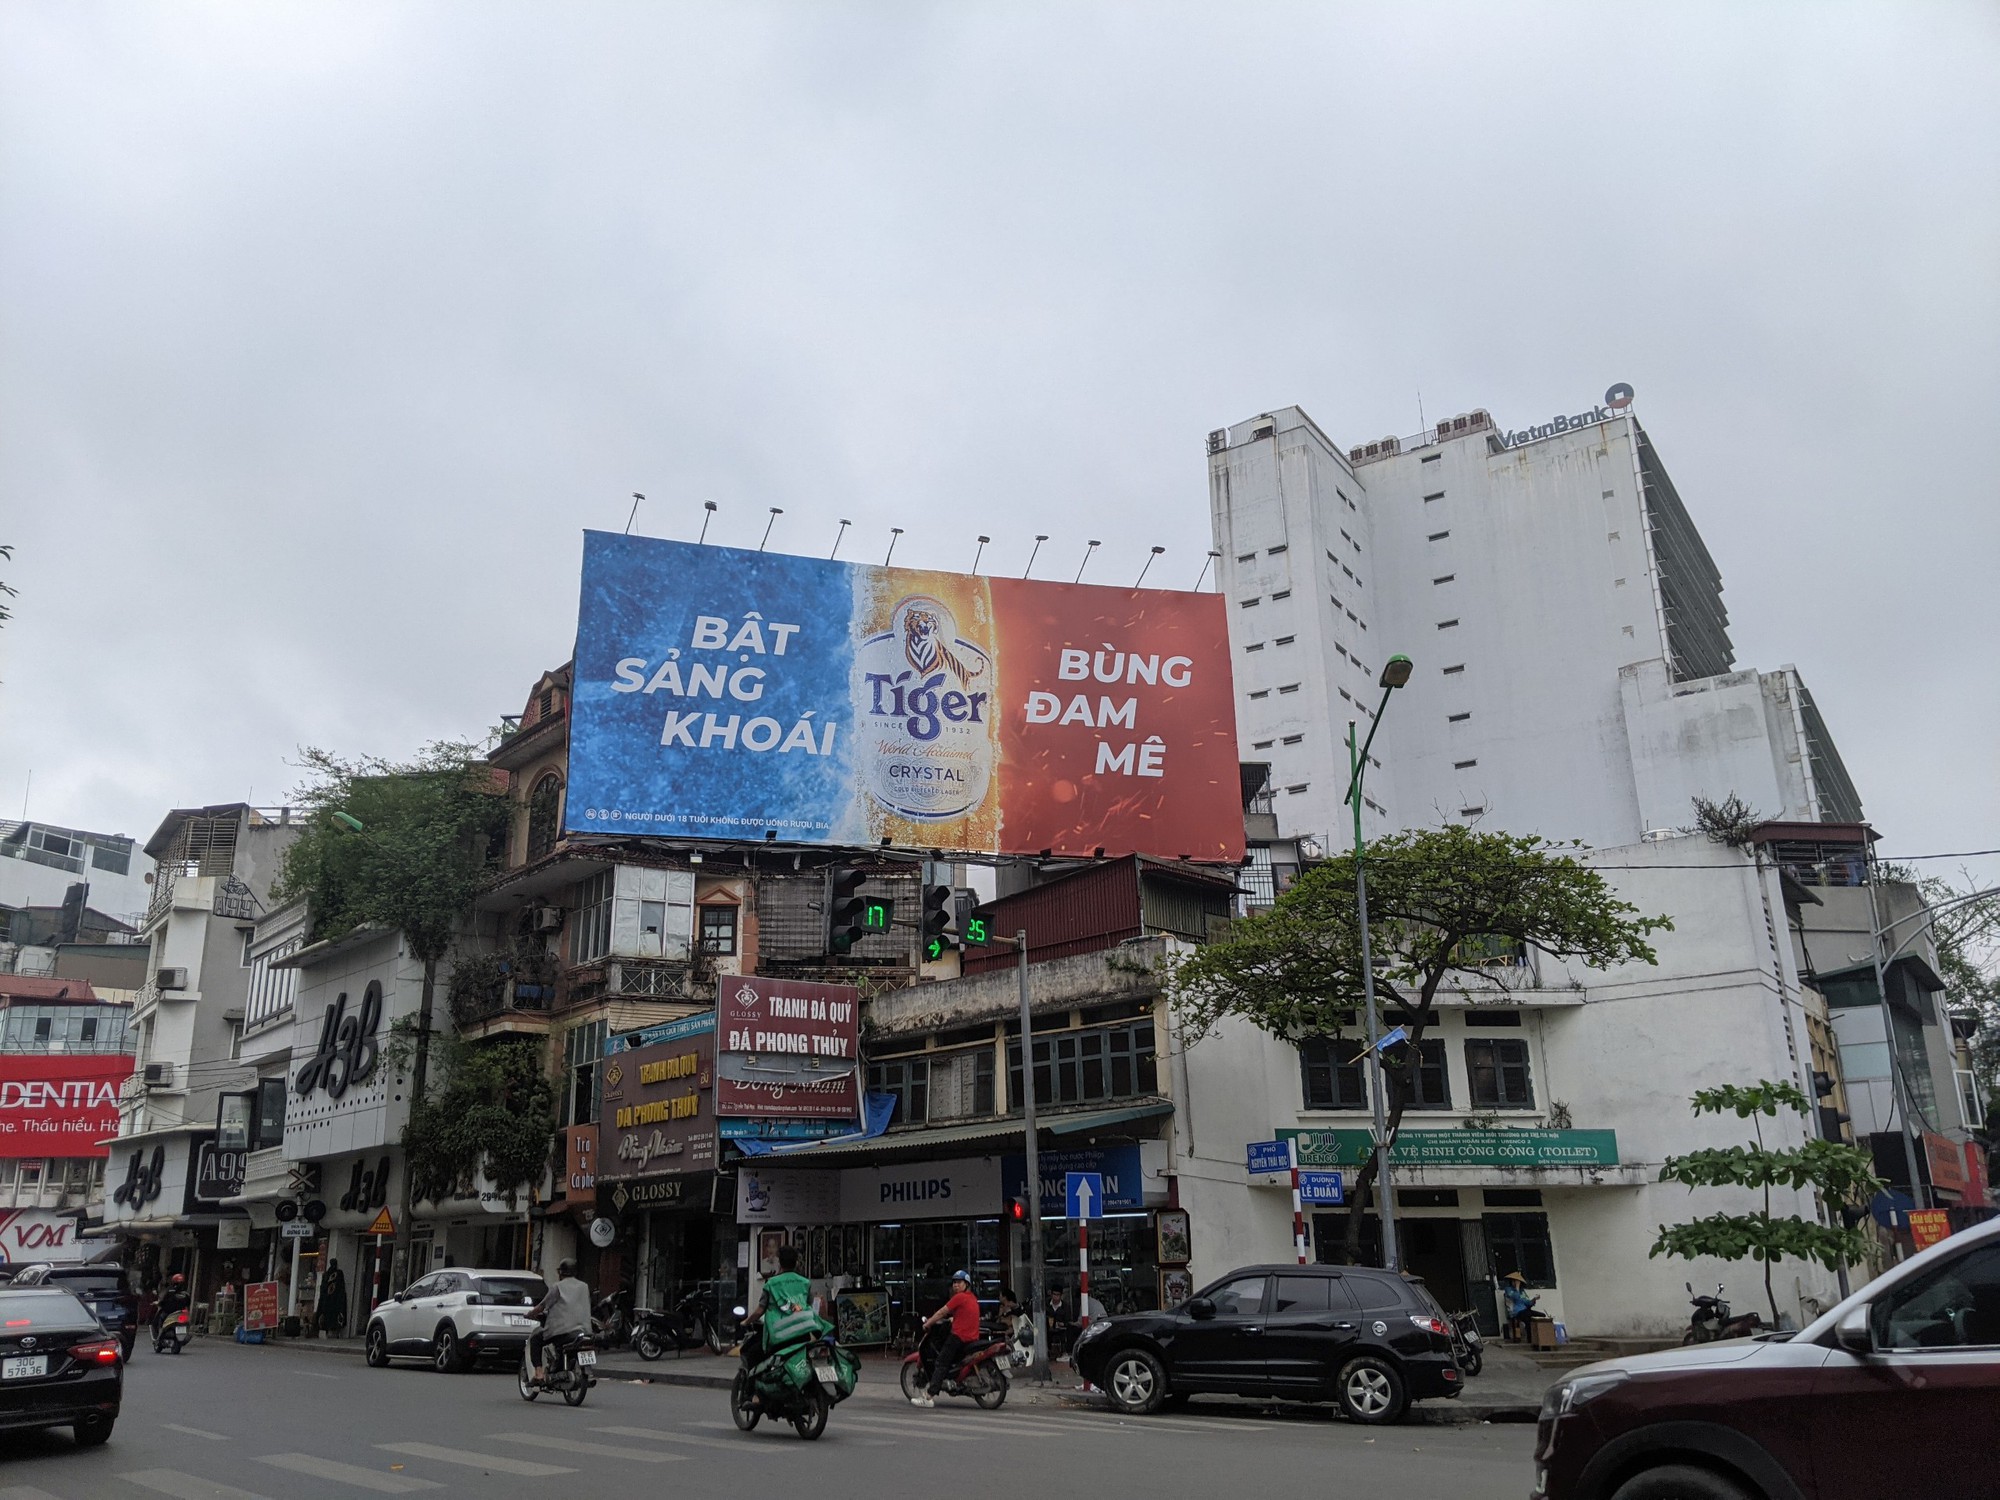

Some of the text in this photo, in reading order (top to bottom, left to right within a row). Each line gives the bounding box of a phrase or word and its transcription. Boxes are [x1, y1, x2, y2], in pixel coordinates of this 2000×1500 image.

[691, 611, 800, 662] BẬT
[1058, 642, 1194, 688] BÙNG
[610, 648, 767, 702] SẢNG
[864, 670, 988, 742] Tiger
[1024, 691, 1138, 729] ĐAM
[874, 721, 903, 729] SINCE
[660, 711, 837, 756] KHOÁI
[1095, 736, 1167, 778] MÊ
[889, 765, 965, 781] CRYSTAL
[625, 811, 653, 821] NGƯỜI
[654, 813, 676, 822] DƯỚI
[678, 815, 688, 823] 18
[689, 814, 709, 823] TUỔI
[710, 815, 739, 825] KHÔNG
[868, 905, 884, 927] 17
[730, 1010, 762, 1018] GLOSSY
[769, 996, 852, 1024] TRANH ĐÁ QUÝ
[729, 1026, 848, 1057] ĐÁ PHONG THỦY
[634, 1100, 670, 1125] PHONG
[22, 1118, 58, 1132] Thấu
[62, 1117, 96, 1132] hiểu.
[576, 1136, 590, 1152] Trà
[1263, 1144, 1276, 1153] PHỐ
[1400, 1144, 1419, 1157] VỆ
[1421, 1146, 1455, 1156] SINH
[1458, 1144, 1495, 1156] CÔNG
[1498, 1144, 1535, 1158] CỘNG
[580, 1157, 587, 1169] &
[1299, 1153, 1339, 1164] URENCO
[1311, 1176, 1335, 1184] ĐƯỜNG
[632, 1181, 682, 1201] GLOSSY
[880, 1178, 951, 1202] PHILIPS
[1301, 1182, 1339, 1198] LÊ DUẨN
[16, 1358, 35, 1367] 30G
[8, 1366, 42, 1377] 578.36
